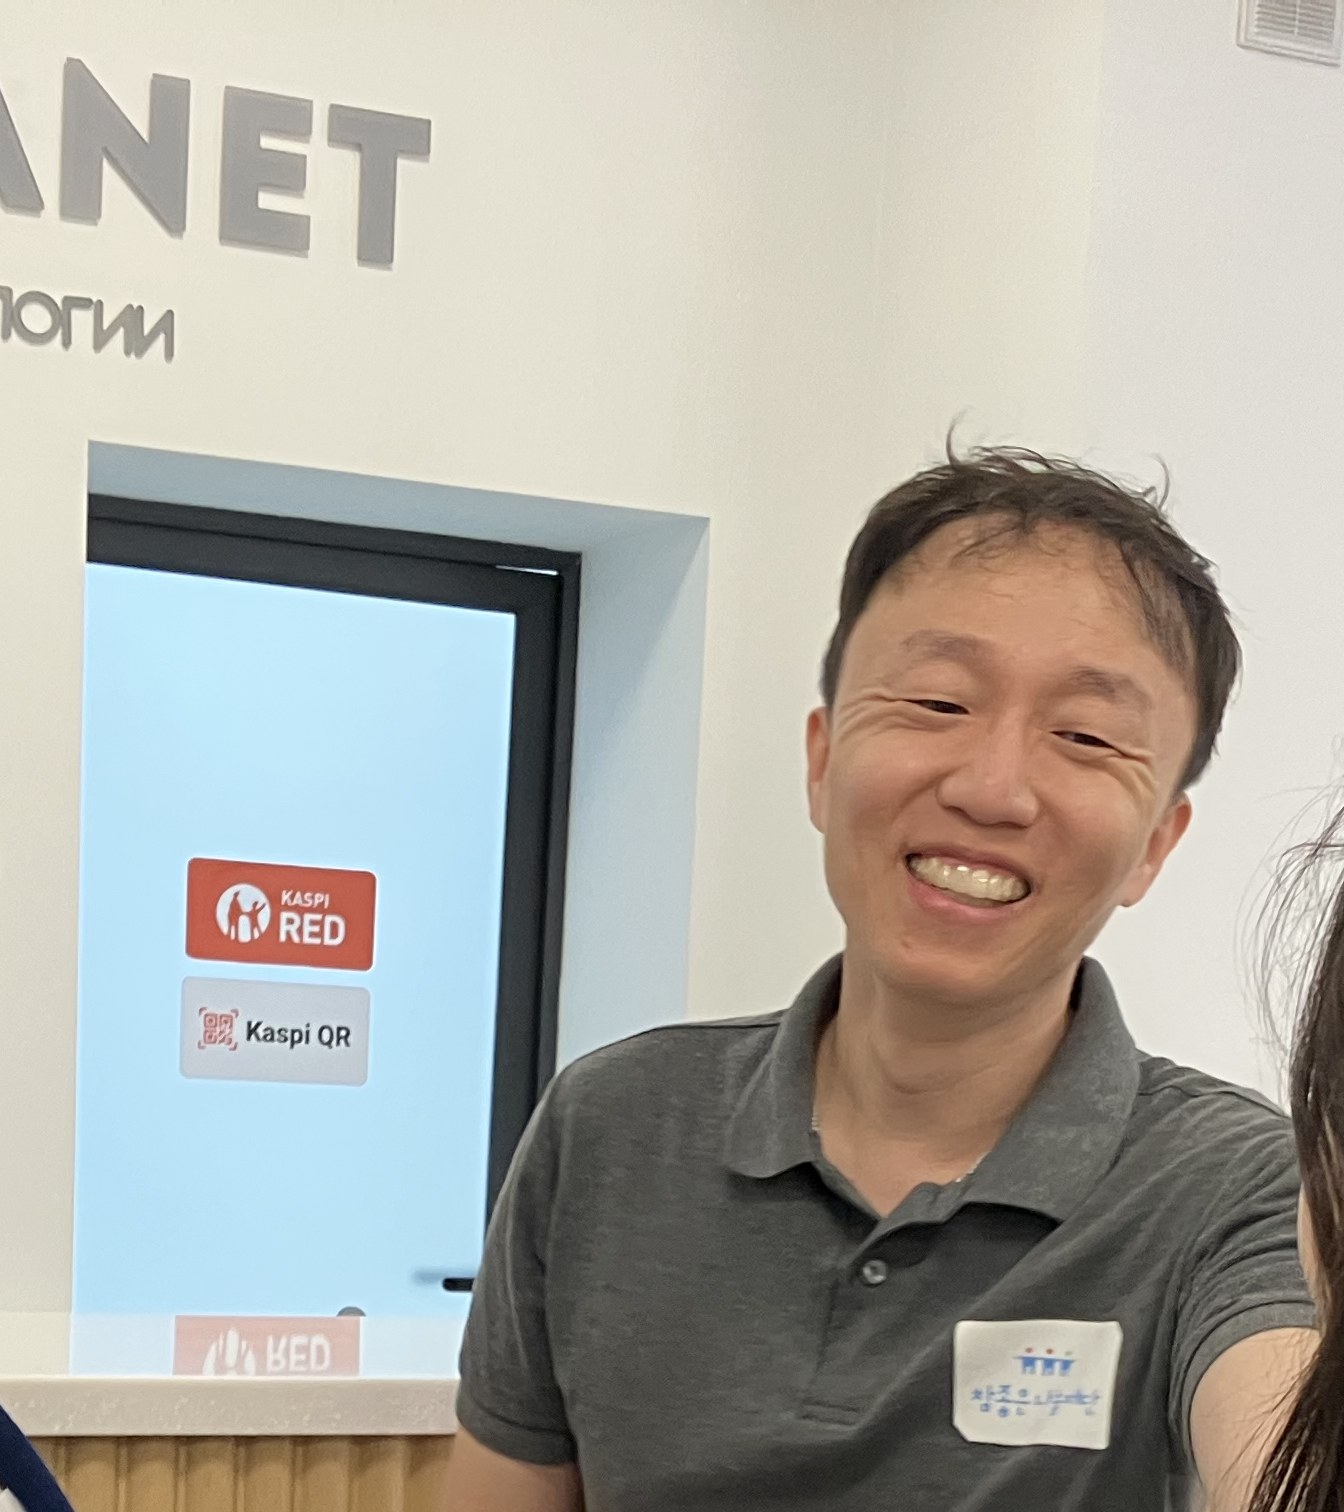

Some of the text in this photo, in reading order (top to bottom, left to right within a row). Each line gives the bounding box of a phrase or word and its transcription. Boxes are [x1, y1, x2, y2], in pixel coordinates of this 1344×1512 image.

[280, 889, 330, 909] KASPI
[278, 910, 347, 946] RED
[245, 1020, 352, 1050] Kaspi QR
